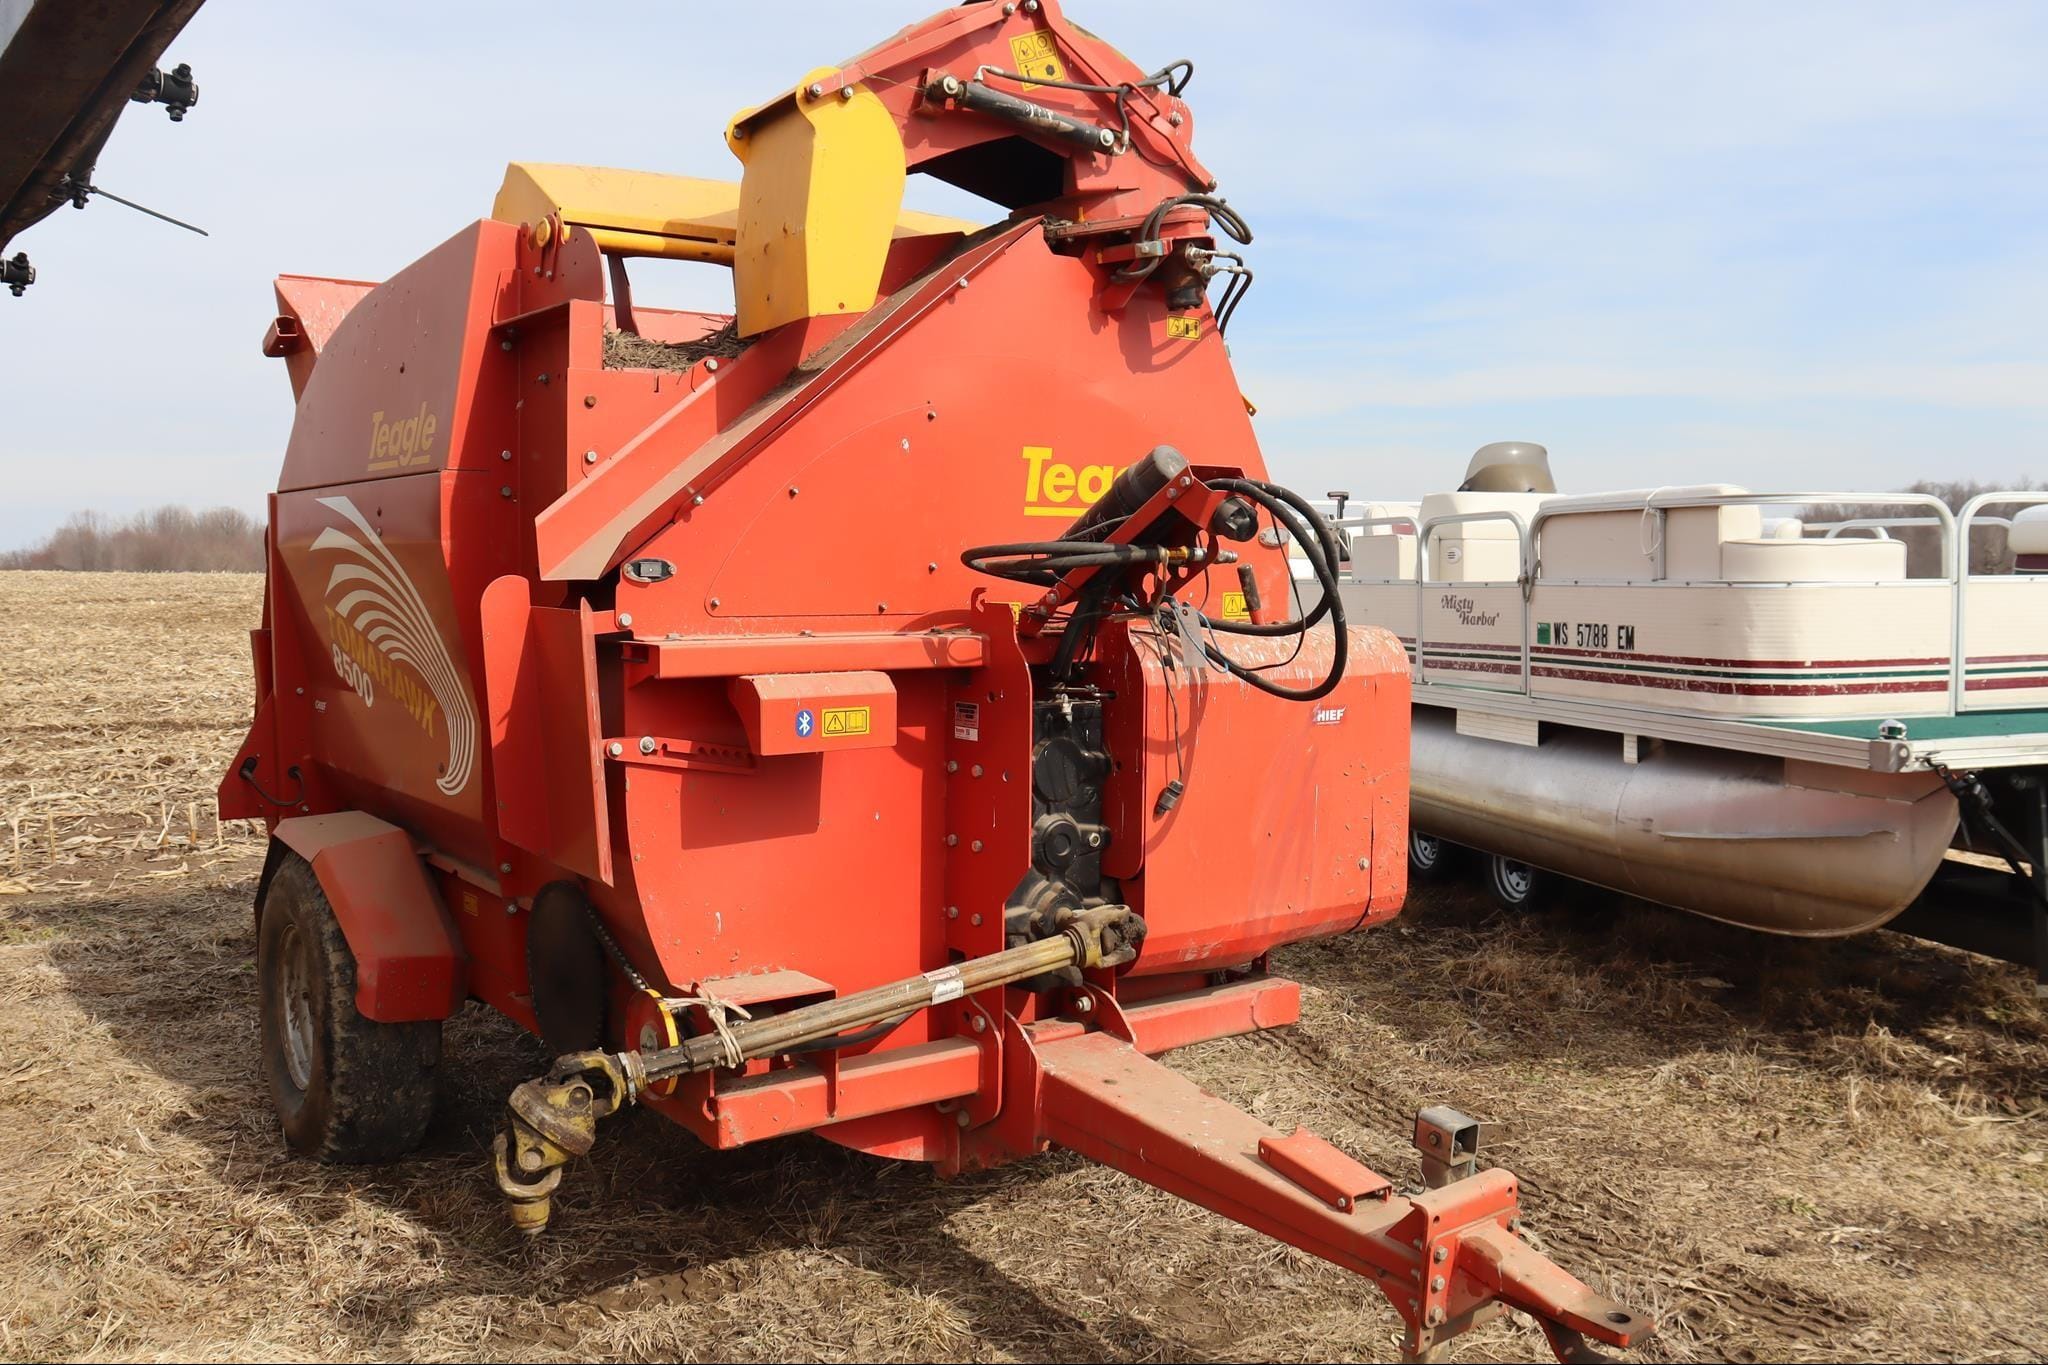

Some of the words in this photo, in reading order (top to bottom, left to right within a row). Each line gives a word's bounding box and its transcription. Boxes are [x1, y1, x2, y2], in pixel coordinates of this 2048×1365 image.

[369, 401, 437, 466] Teagle
[1022, 446, 1128, 504] Tea
[1441, 595, 1474, 614] Misty
[1459, 610, 1500, 626] Harbor
[1554, 622, 1568, 645] WS
[1577, 623, 1608, 648] 5788
[1617, 625, 1635, 650] EM
[325, 605, 436, 738] TOMAHAWK
[332, 643, 373, 708] 8500
